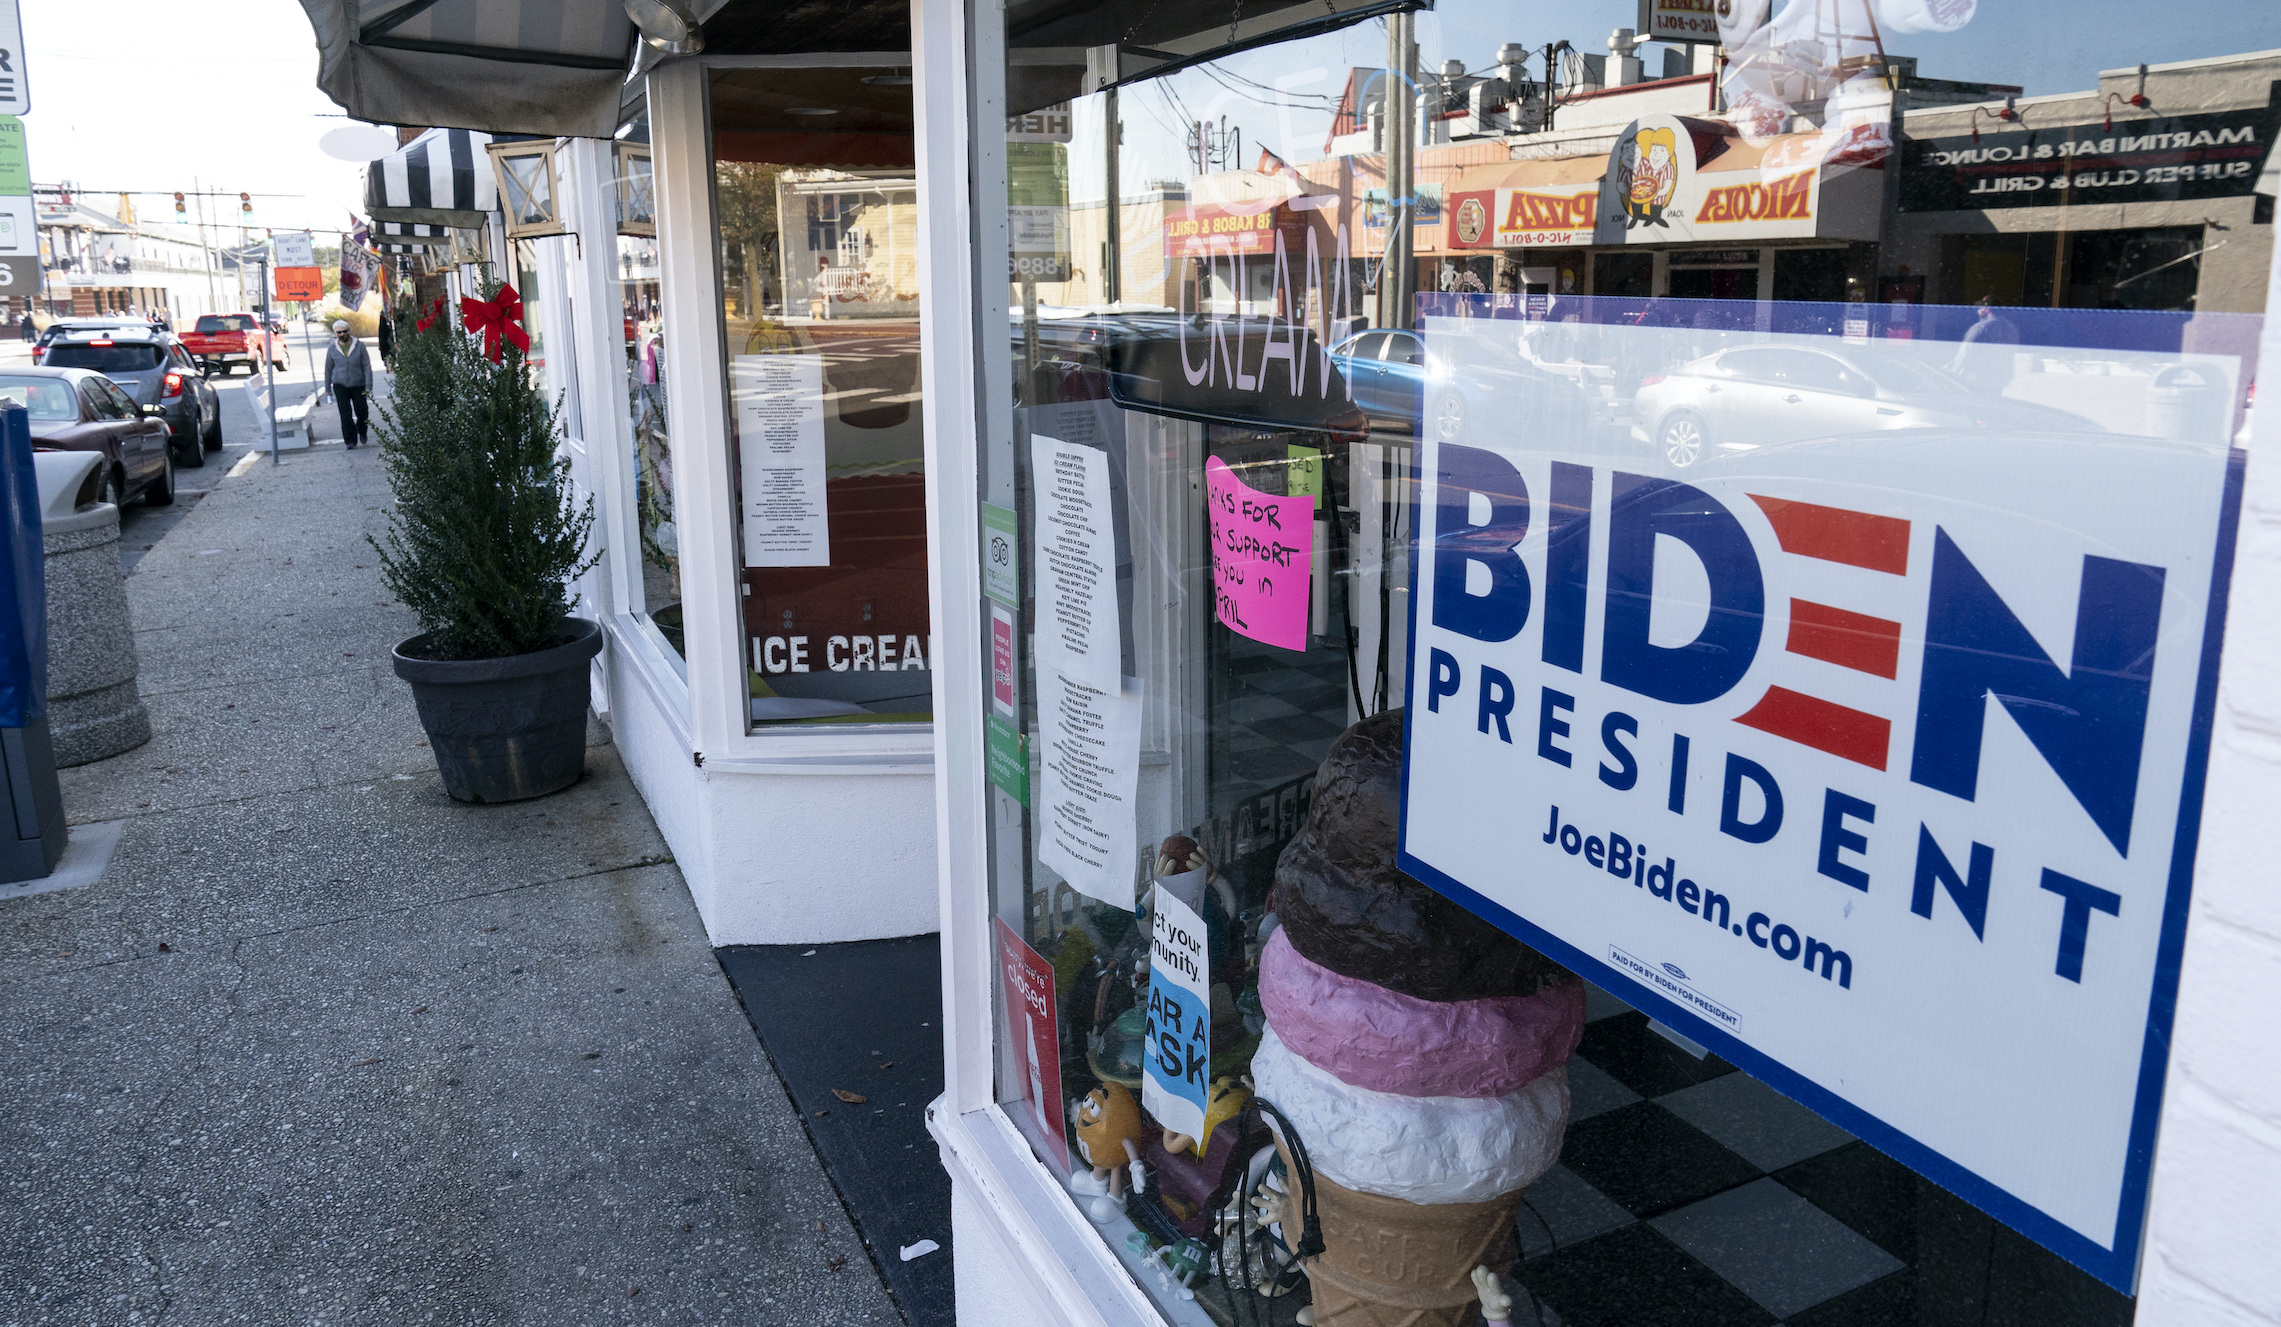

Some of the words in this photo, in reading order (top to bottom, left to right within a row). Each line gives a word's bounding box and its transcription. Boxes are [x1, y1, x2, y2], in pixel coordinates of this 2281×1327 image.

[279, 281, 318, 289] DETOUR
[1060, 504, 1084, 513] CHOCOLATE
[1209, 483, 1235, 514] ANKS
[1242, 500, 1282, 531] FOR
[1057, 511, 1079, 520] CHOCOLATE
[1062, 520, 1085, 530] CHOCOLATE
[1059, 544, 1075, 552] COTTON
[1226, 529, 1300, 568] SUPPORT
[1061, 561, 1084, 572] CHOCOLATE
[1224, 560, 1245, 585] YOU
[995, 633, 1010, 647] PEOPLE
[752, 636, 810, 673] ICE
[826, 634, 931, 673] CREA
[1429, 441, 2166, 858] BIDEN
[1083, 711, 1102, 720] FOSTER
[1083, 720, 1104, 729] TRUFFLE
[1080, 751, 1098, 761] CHERRY
[1093, 763, 1114, 774] TRUFFLE
[1103, 793, 1122, 802] DOUGH
[1427, 646, 2121, 985] PRESIDENT
[1089, 843, 1109, 855] YOGURT
[1084, 858, 1103, 869] CHERRY
[1541, 804, 1853, 990] JoeBiden.com
[1168, 922, 1201, 957] your
[1007, 963, 1048, 1019] closed
[1612, 951, 1629, 966] PAID
[1629, 961, 1644, 975] FOR
[1644, 969, 1655, 980] BY
[1654, 975, 1678, 993] BIDEN
[1677, 988, 1694, 1002] FOR
[1694, 996, 1737, 1026] PRESIDENT
[1192, 1015, 1207, 1052] A
